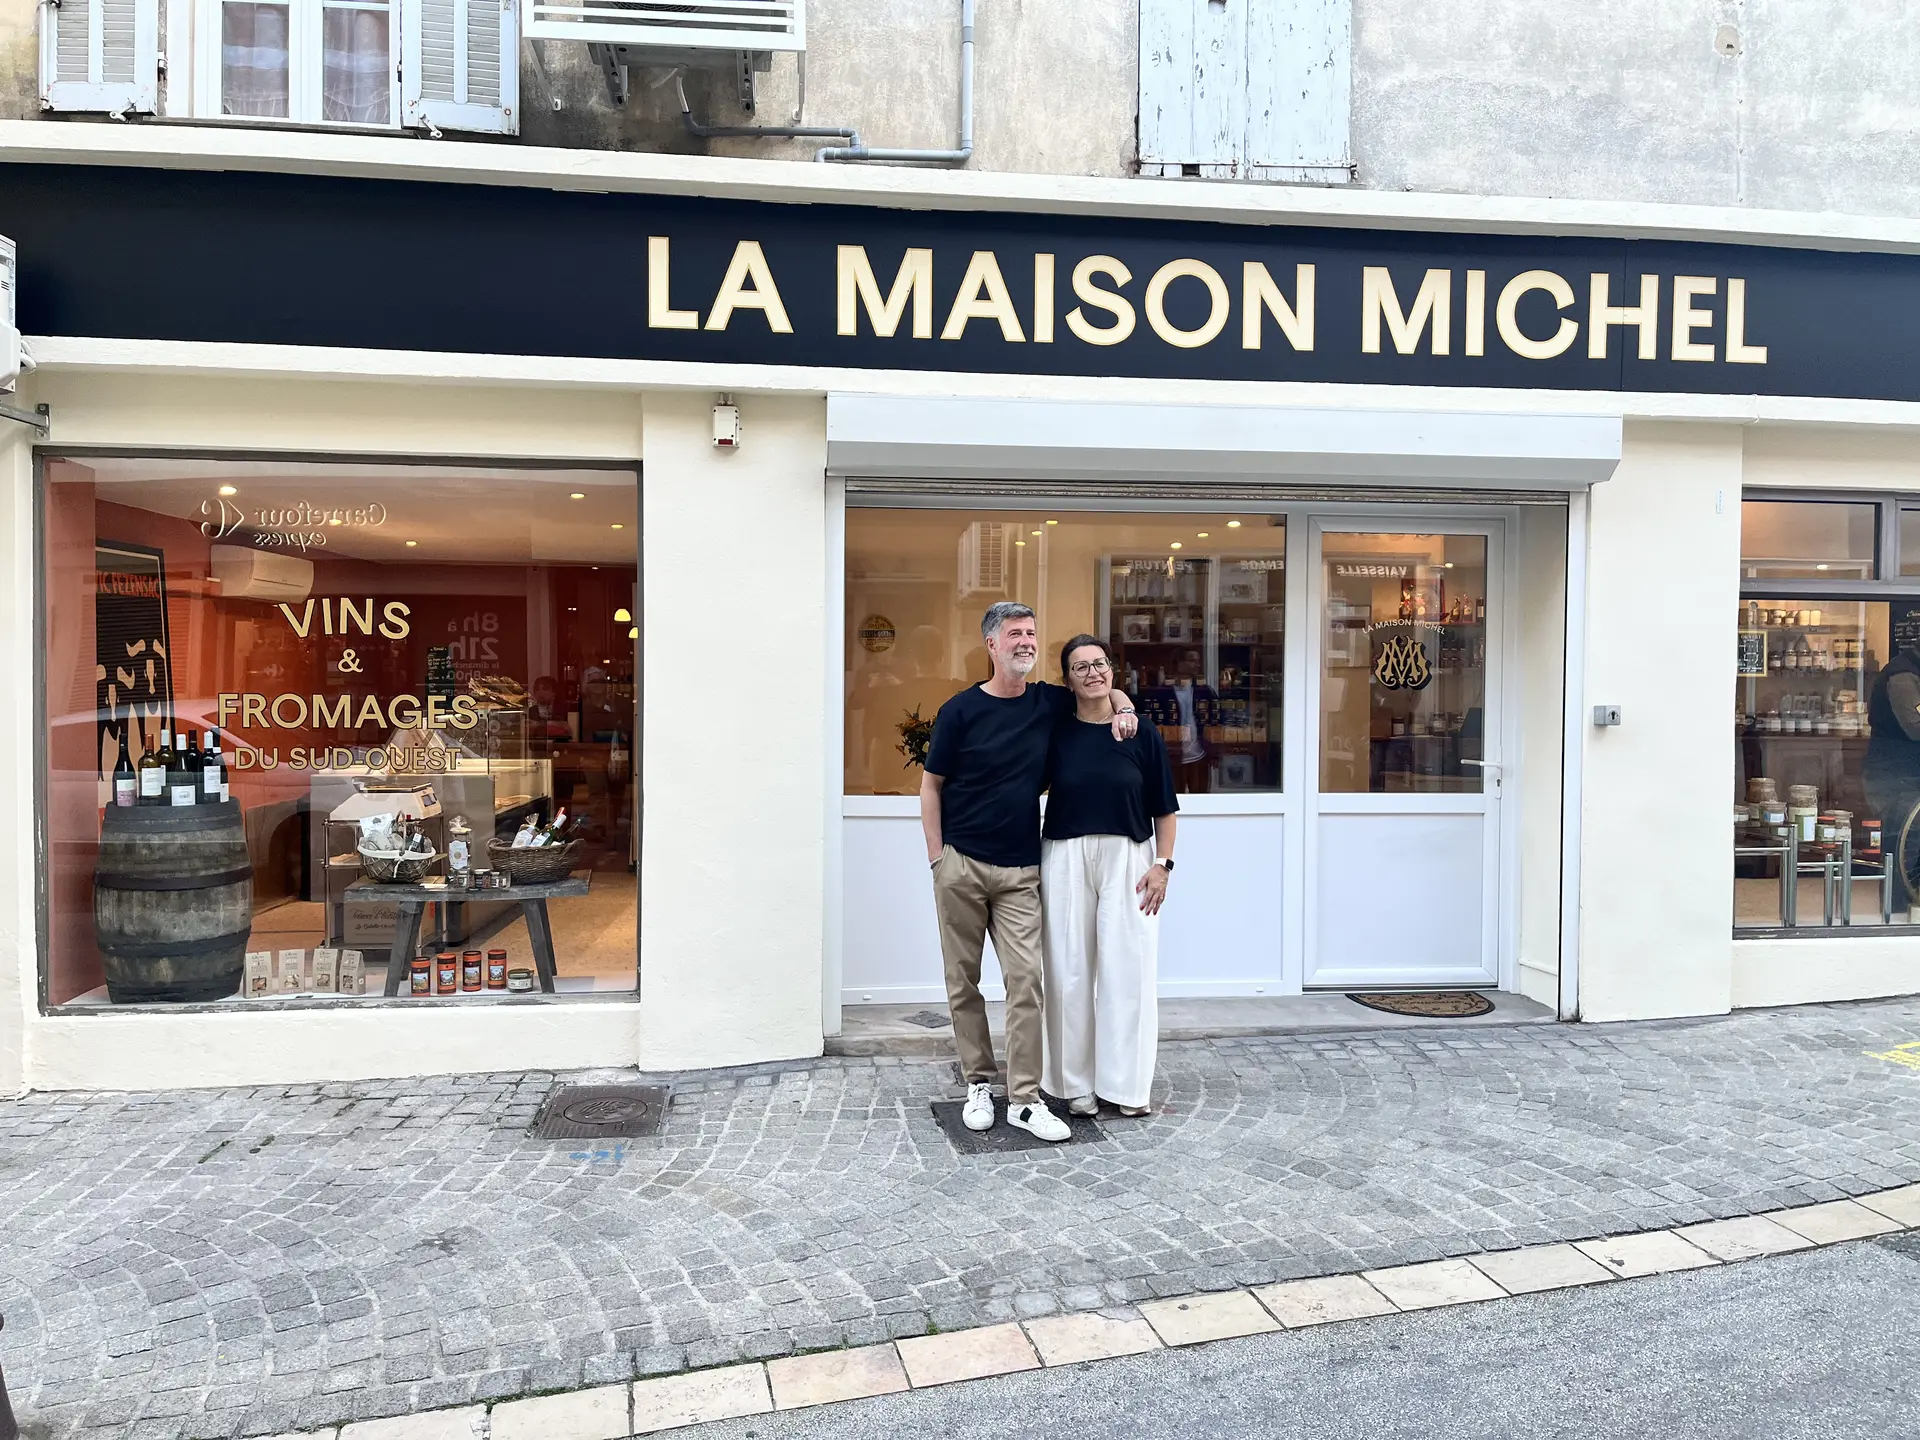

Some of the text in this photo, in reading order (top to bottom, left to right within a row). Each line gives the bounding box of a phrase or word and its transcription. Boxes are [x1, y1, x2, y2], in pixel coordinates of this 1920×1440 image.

[647, 235, 1769, 365] LA MAISON MICHEL
[277, 597, 411, 640] VINS
[1361, 618, 1446, 635] LA MAISON MICHEL
[337, 648, 363, 673] &
[217, 692, 480, 730] FROMAGES
[234, 746, 462, 771] DU SUD-OUEST
